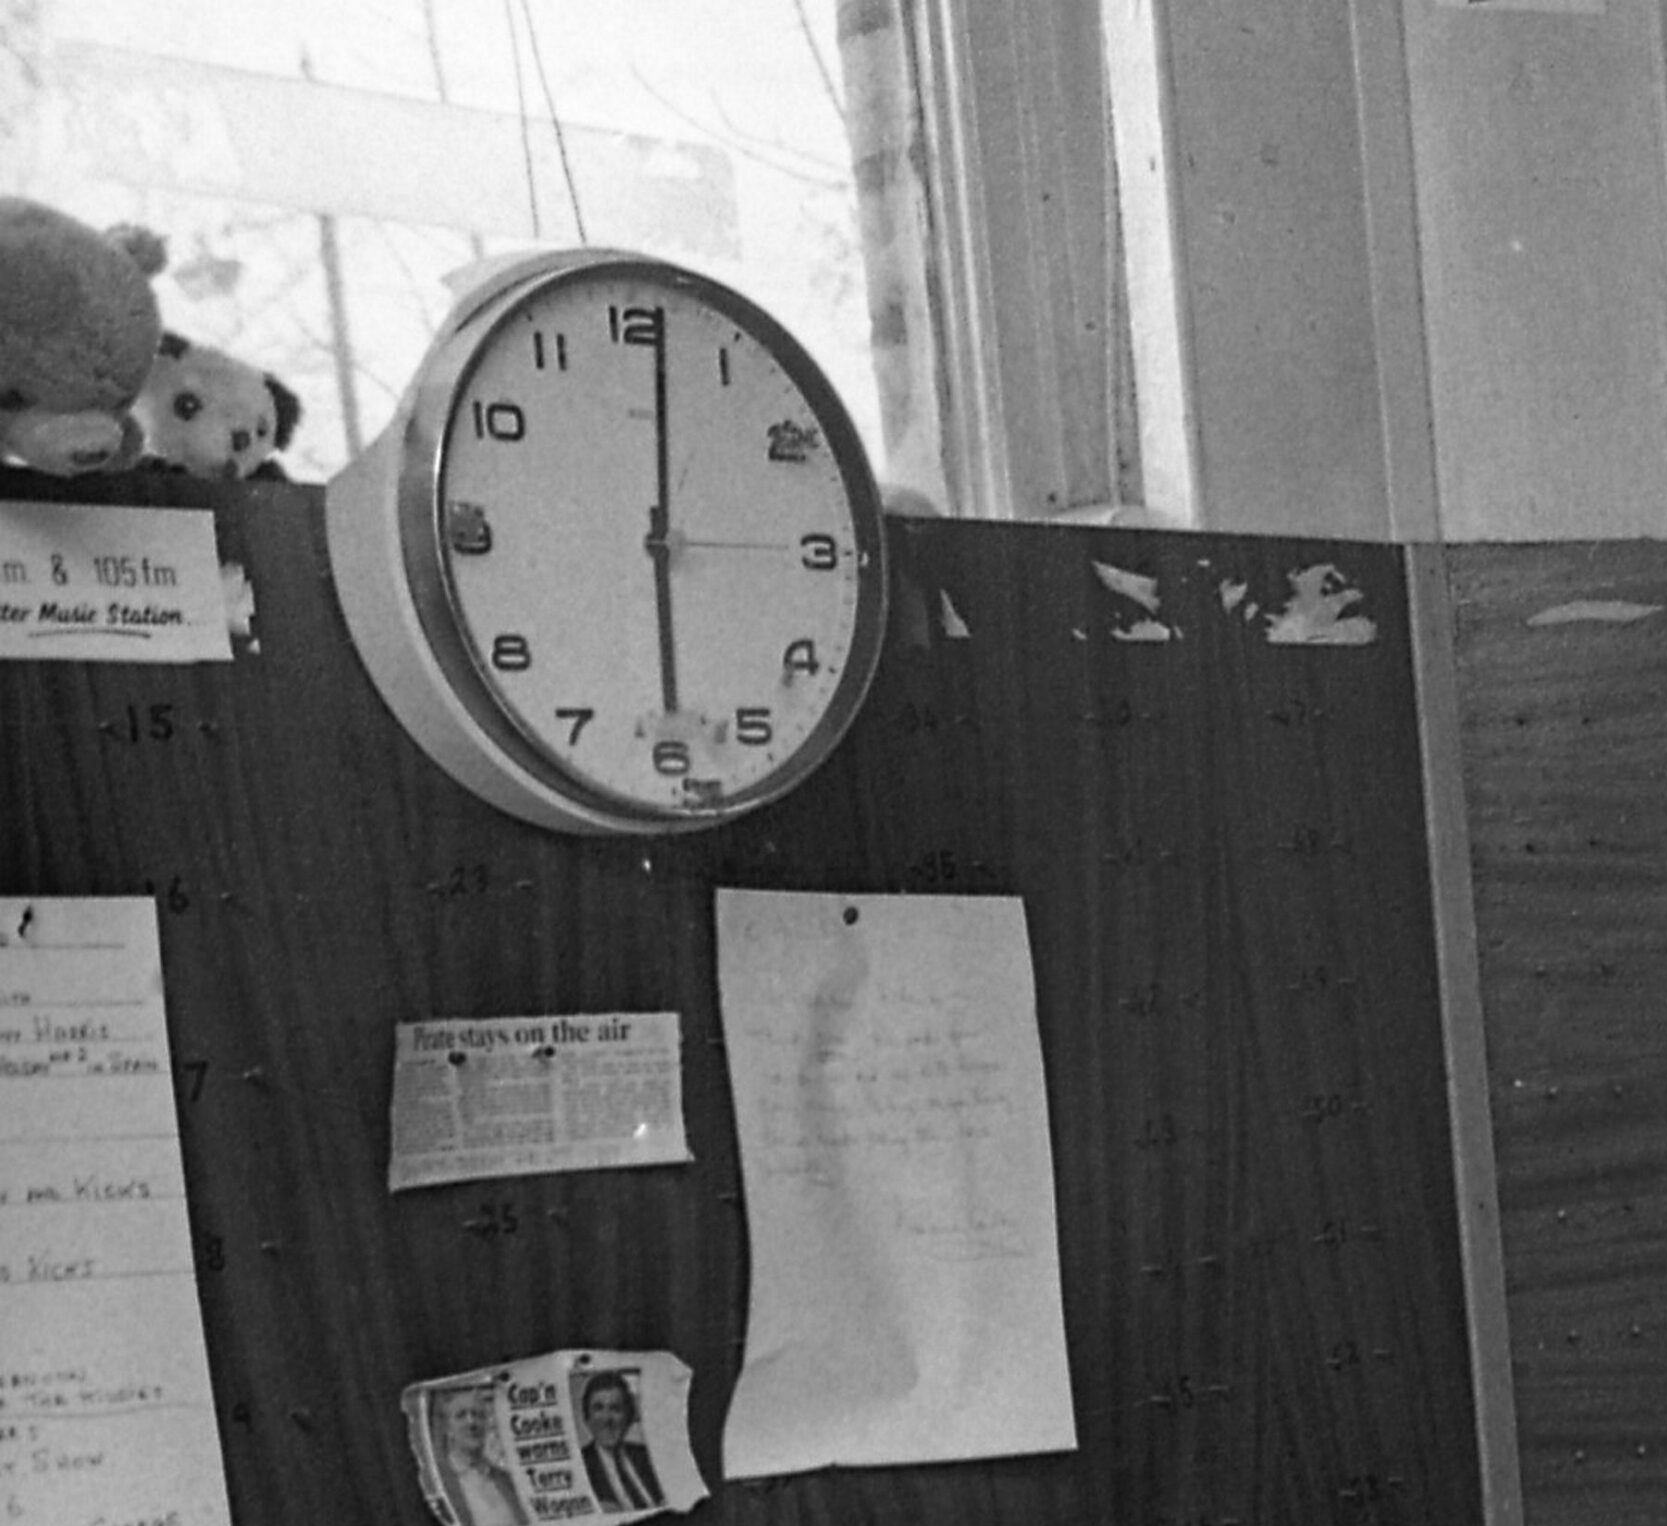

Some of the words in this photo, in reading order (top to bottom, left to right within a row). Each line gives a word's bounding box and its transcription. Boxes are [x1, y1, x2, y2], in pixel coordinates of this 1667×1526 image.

[609, 305, 658, 346] 12
[534, 332, 567, 371] 11
[718, 347, 731, 387] 1
[473, 401, 525, 442] 10
[51, 553, 68, 587] &
[800, 534, 837, 571] 3
[38, 602, 97, 624] Music
[491, 634, 531, 671] 8
[126, 703, 174, 744] 15
[555, 707, 594, 746] 7
[736, 707, 774, 745] 5
[652, 740, 690, 776] 6
[459, 1026, 510, 1052] stays
[514, 1026, 545, 1044] on
[552, 1019, 590, 1043] the
[598, 1017, 632, 1042] air
